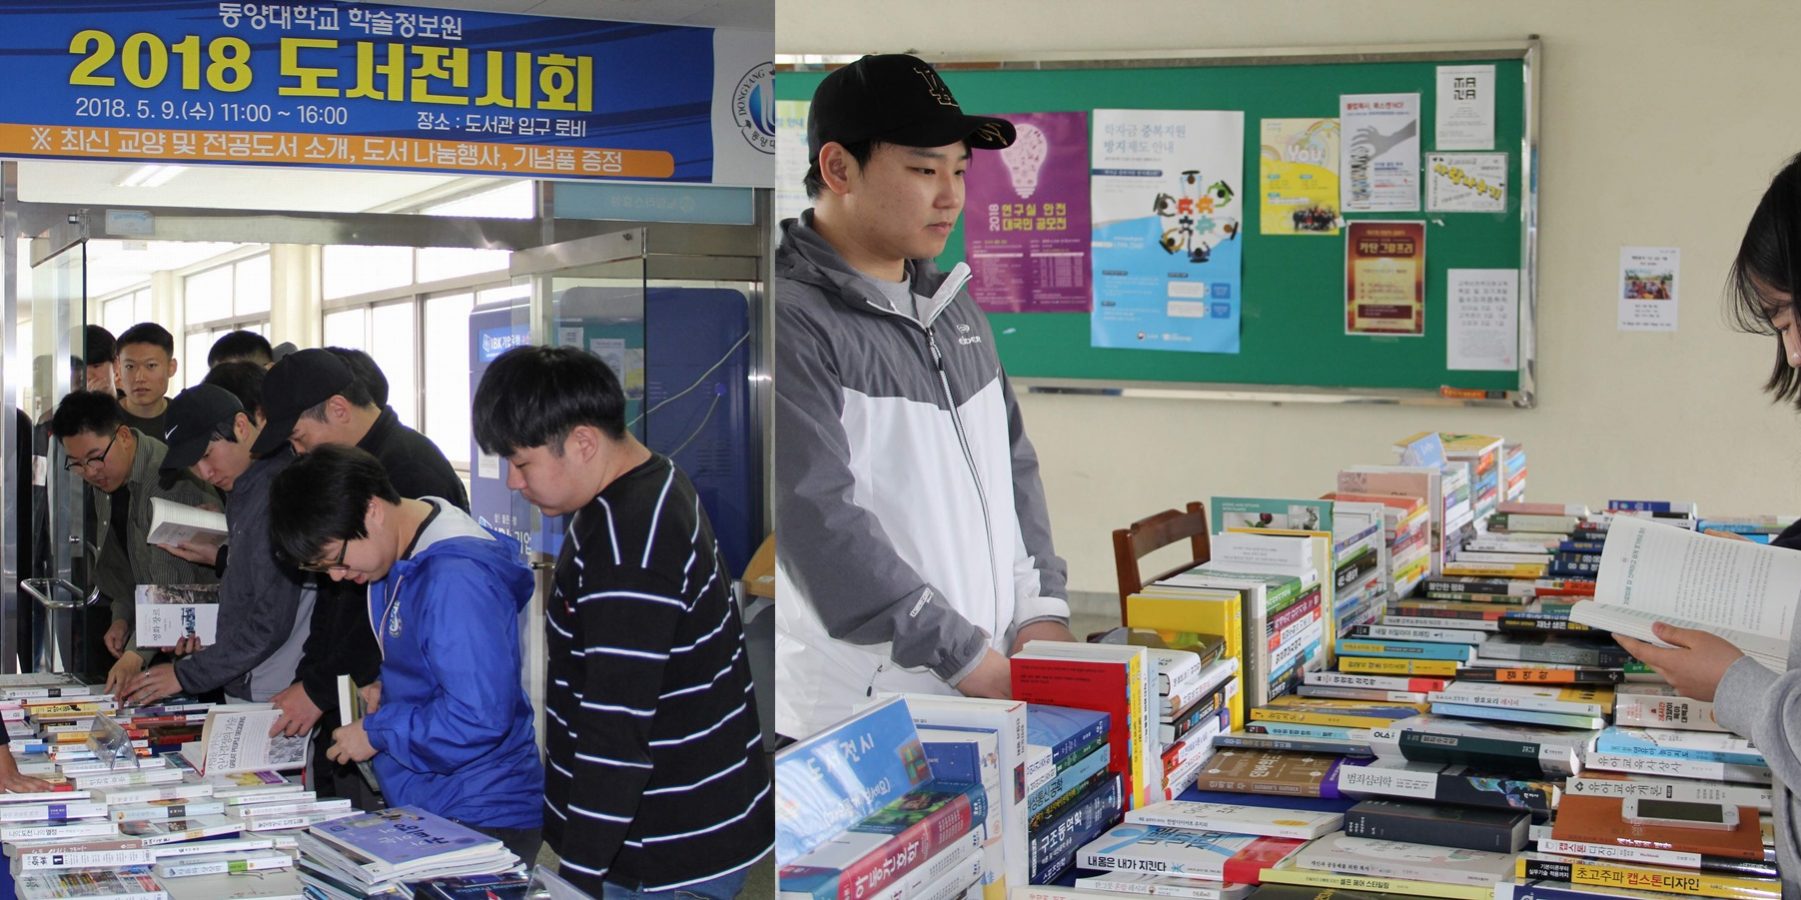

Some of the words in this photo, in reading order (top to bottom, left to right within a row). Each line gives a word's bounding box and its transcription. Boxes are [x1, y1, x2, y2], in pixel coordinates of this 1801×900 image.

[219, 2, 340, 32] 동양대학교
[348, 7, 463, 41] 학술정보원
[68, 29, 253, 93] 2018
[277, 37, 593, 112] 도서전시회
[75, 97, 131, 119] 2018.
[137, 99, 156, 119] 5.
[161, 100, 215, 122] 9.(수)
[221, 102, 272, 122] 11:00
[298, 105, 349, 126] 16:00
[416, 111, 450, 132] 장소
[465, 113, 515, 136] 도서관
[518, 116, 551, 136] 입구
[555, 118, 587, 138] 로비
[60, 128, 110, 154] 최신
[117, 130, 166, 156] 교양
[171, 132, 198, 156] 및
[203, 133, 298, 158] 전공도서
[304, 136, 357, 164] 소개,
[362, 138, 408, 163] 도서
[413, 141, 507, 171] 나눔행사,
[513, 146, 576, 172] 기념품
[581, 150, 623, 174] 증정
[989, 203, 1000, 232] 2018
[1002, 203, 1037, 217] 연구실
[1043, 202, 1067, 217] 안전
[1002, 217, 1033, 231] 대국민
[1036, 217, 1068, 231] 공모전
[1347, 772, 1392, 788] 범죄심리학
[1040, 810, 1083, 854] 구조동역학
[1558, 842, 1587, 853] 캡스톤
[1588, 844, 1616, 857] 디자인
[1087, 855, 1115, 869] 내몸은
[1117, 857, 1137, 870] 내가
[1138, 859, 1167, 873] 지킨다
[1576, 866, 1624, 884] 초고주파
